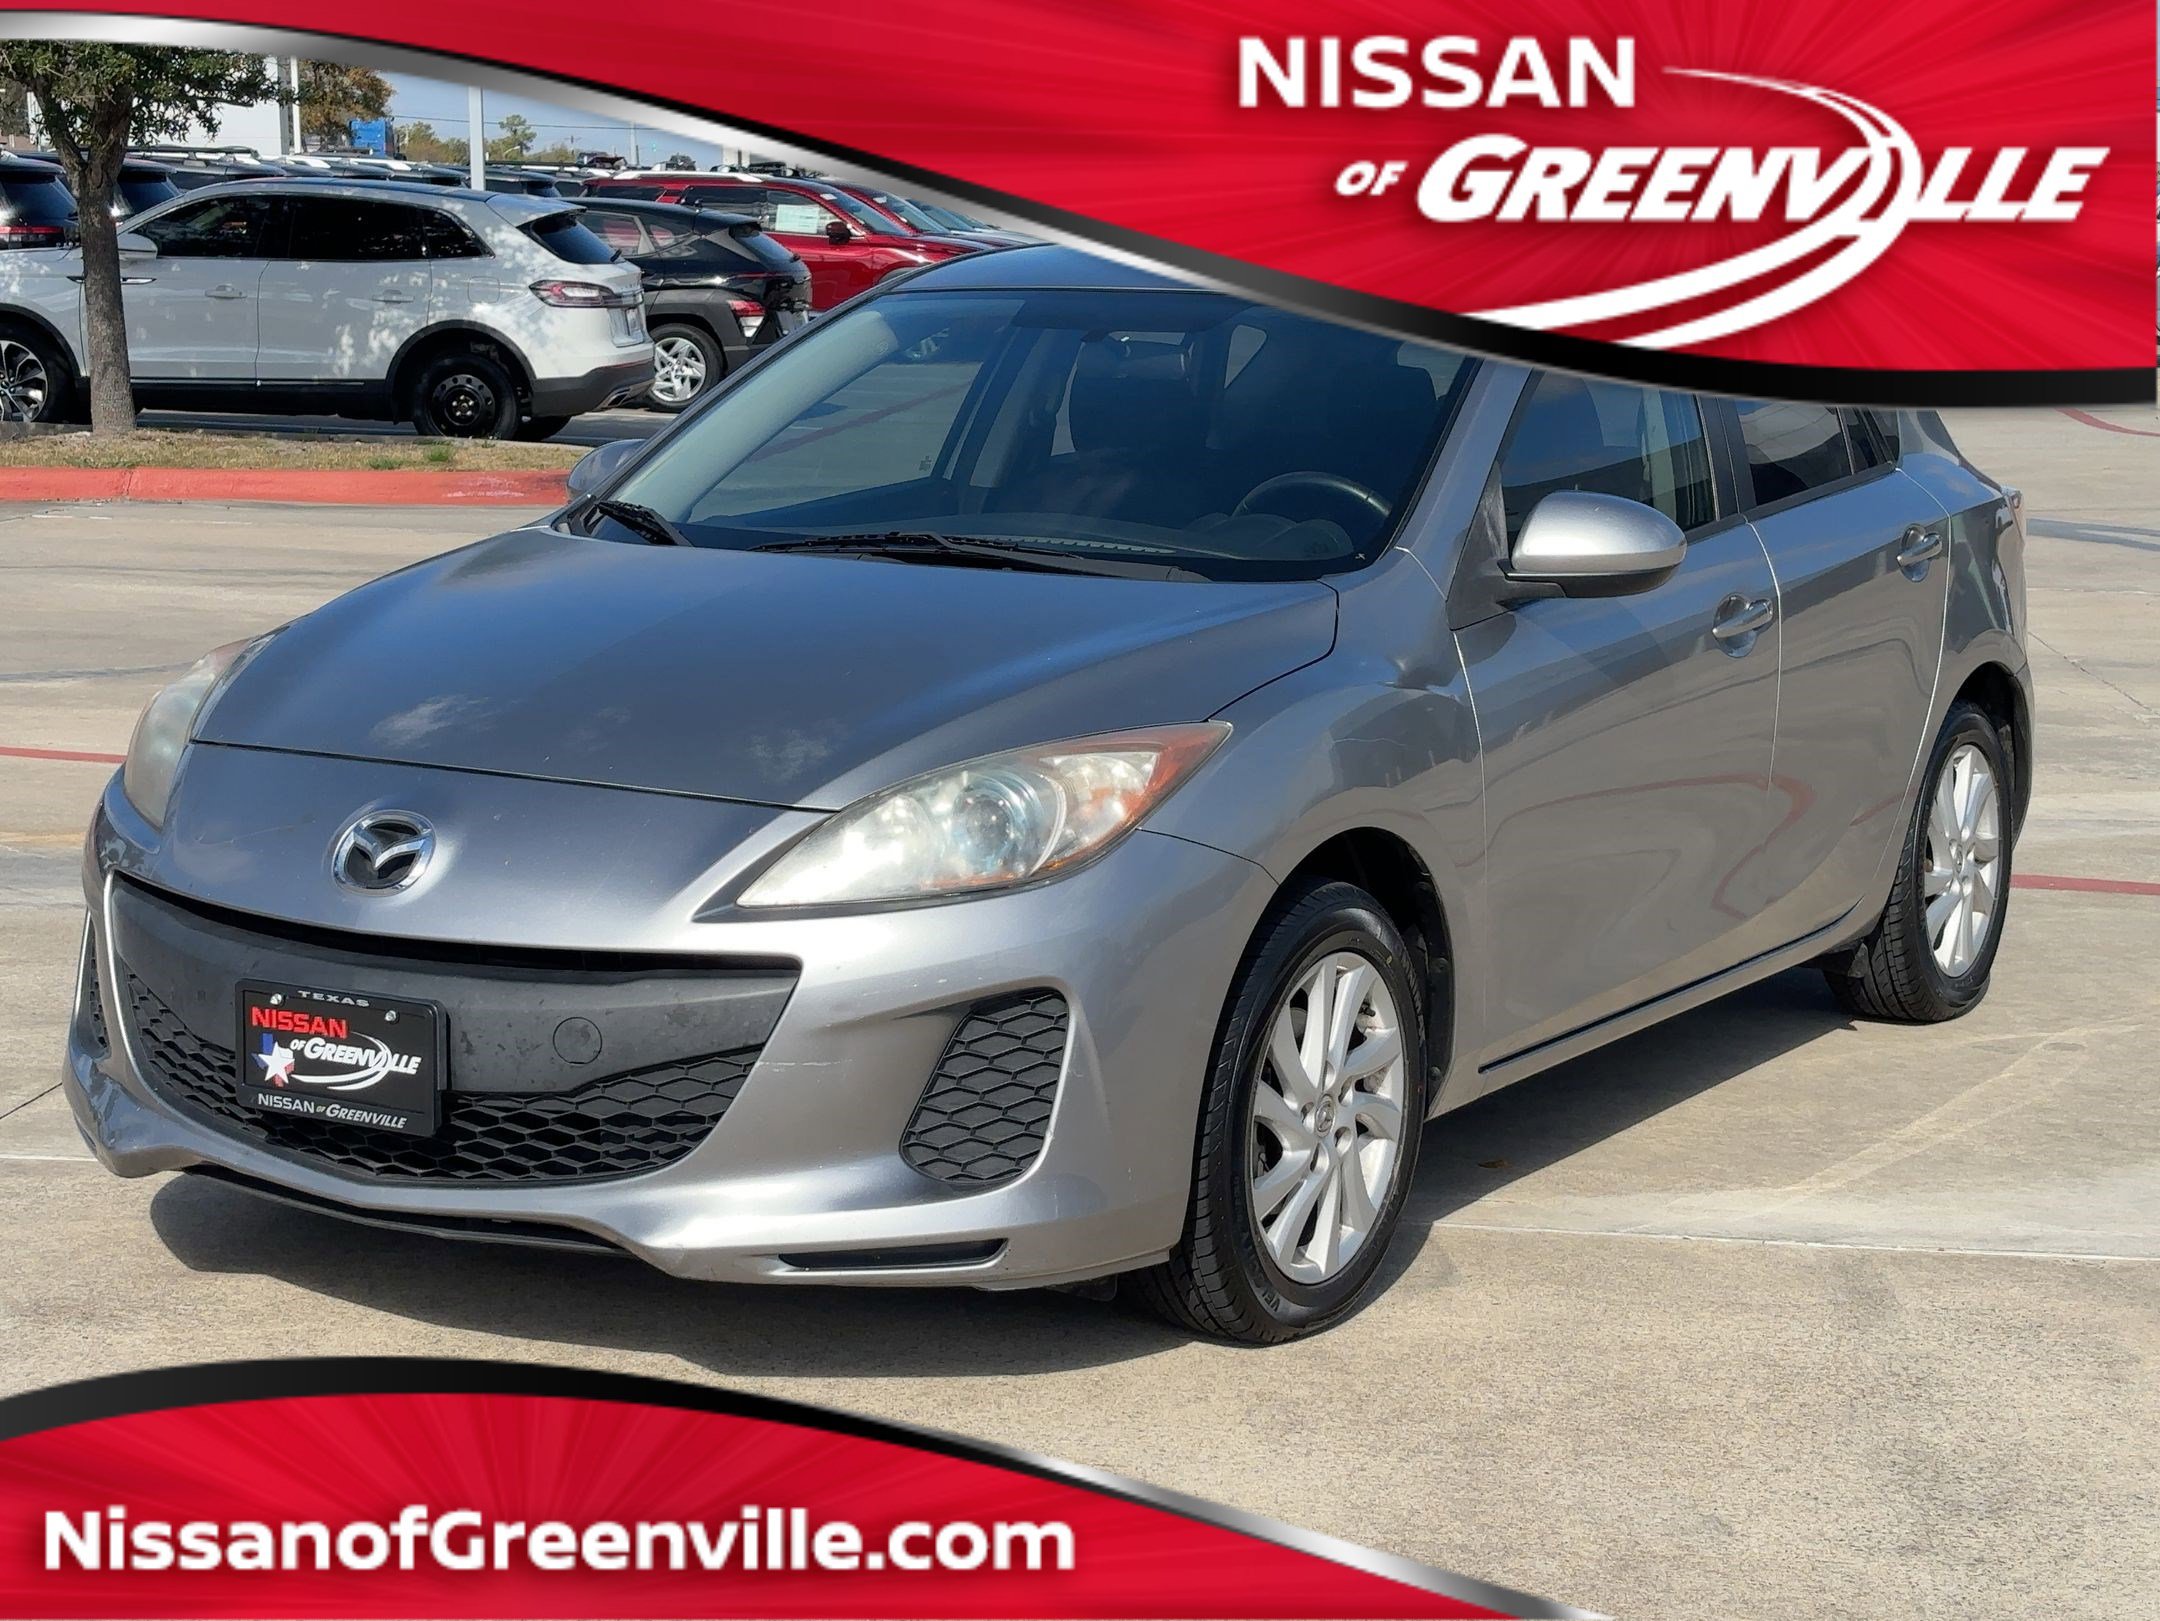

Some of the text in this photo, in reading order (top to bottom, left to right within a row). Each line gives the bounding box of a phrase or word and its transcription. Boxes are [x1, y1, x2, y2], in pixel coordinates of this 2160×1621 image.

[298, 990, 370, 1007] TEXAS
[251, 1006, 348, 1039] NISSAN
[290, 1038, 306, 1051] OF
[258, 1093, 315, 1114] NISSAN
[326, 1103, 407, 1129] GREENVILLE
